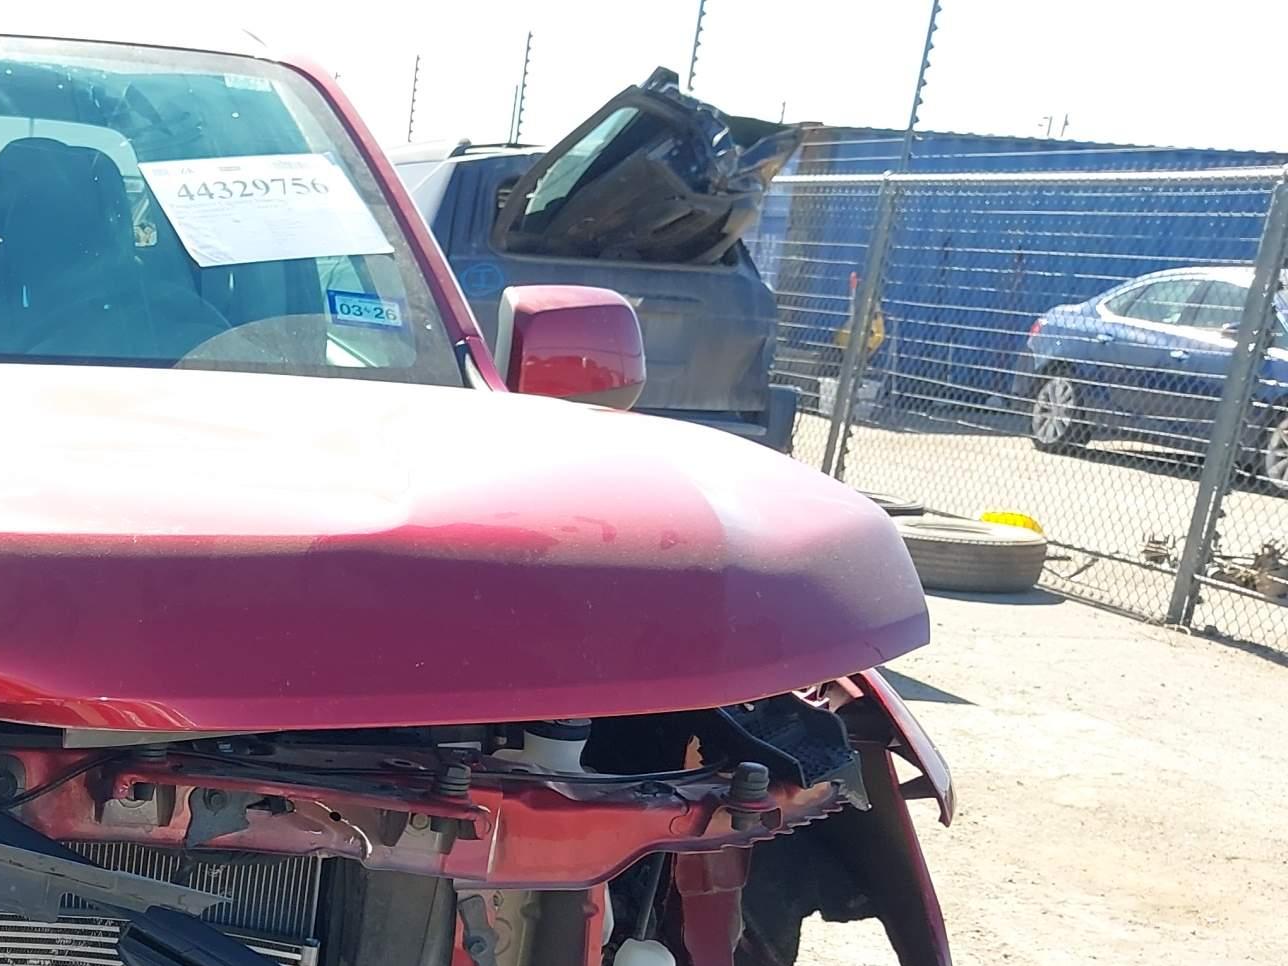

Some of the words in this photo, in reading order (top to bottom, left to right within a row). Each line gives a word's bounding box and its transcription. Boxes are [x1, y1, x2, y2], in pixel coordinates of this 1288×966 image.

[176, 177, 329, 201] 44329756
[339, 303, 363, 317] 03
[373, 307, 397, 321] 26
